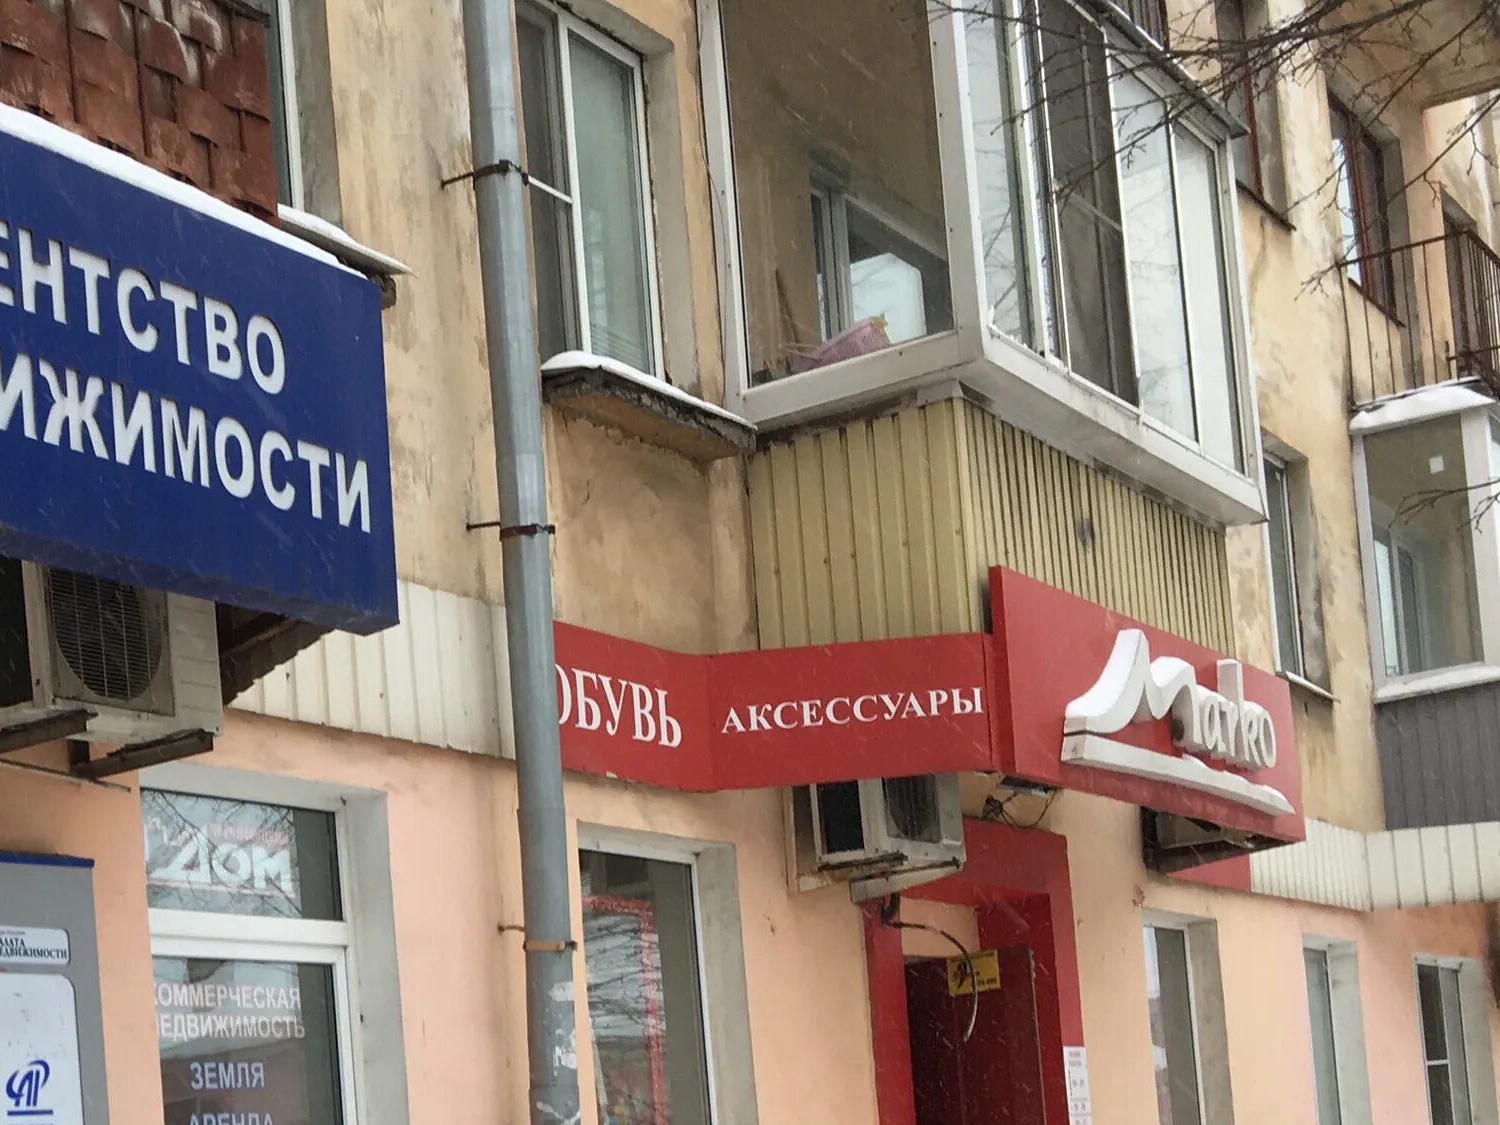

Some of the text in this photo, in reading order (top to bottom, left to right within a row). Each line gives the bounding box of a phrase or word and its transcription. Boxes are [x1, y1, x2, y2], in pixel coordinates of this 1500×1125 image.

[720, 686, 984, 735] АКСЕССУАРЫ
[1063, 628, 1277, 770] Marko
[153, 982, 301, 1010] ОММЕРЧЕСКАЯ
[156, 1013, 306, 1043] ЕДВИЖИМОСТЬ
[190, 1061, 266, 1090] ЗЕМЛЯ
